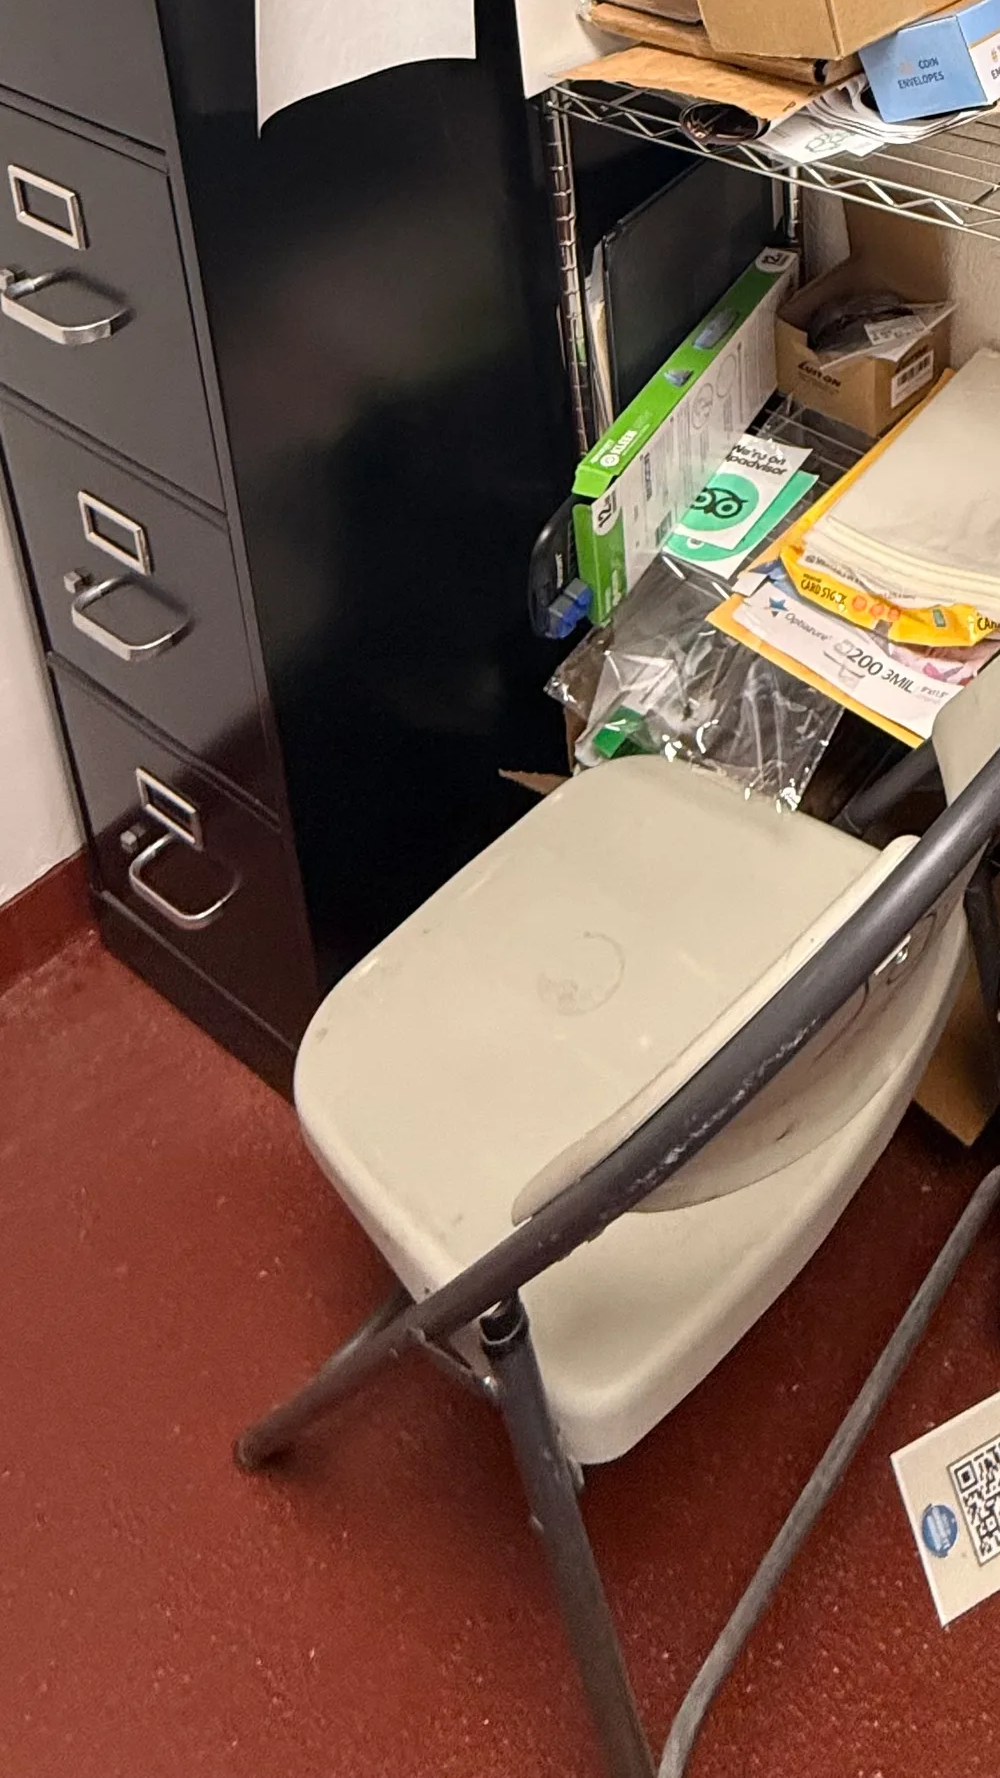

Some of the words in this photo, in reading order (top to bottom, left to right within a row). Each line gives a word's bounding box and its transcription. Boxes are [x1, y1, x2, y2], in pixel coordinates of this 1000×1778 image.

[917, 57, 940, 70] COIN
[897, 70, 946, 90] ENVELOPES
[800, 578, 820, 597] CARD
[846, 647, 885, 676] 200
[880, 668, 916, 694] 3MIL
